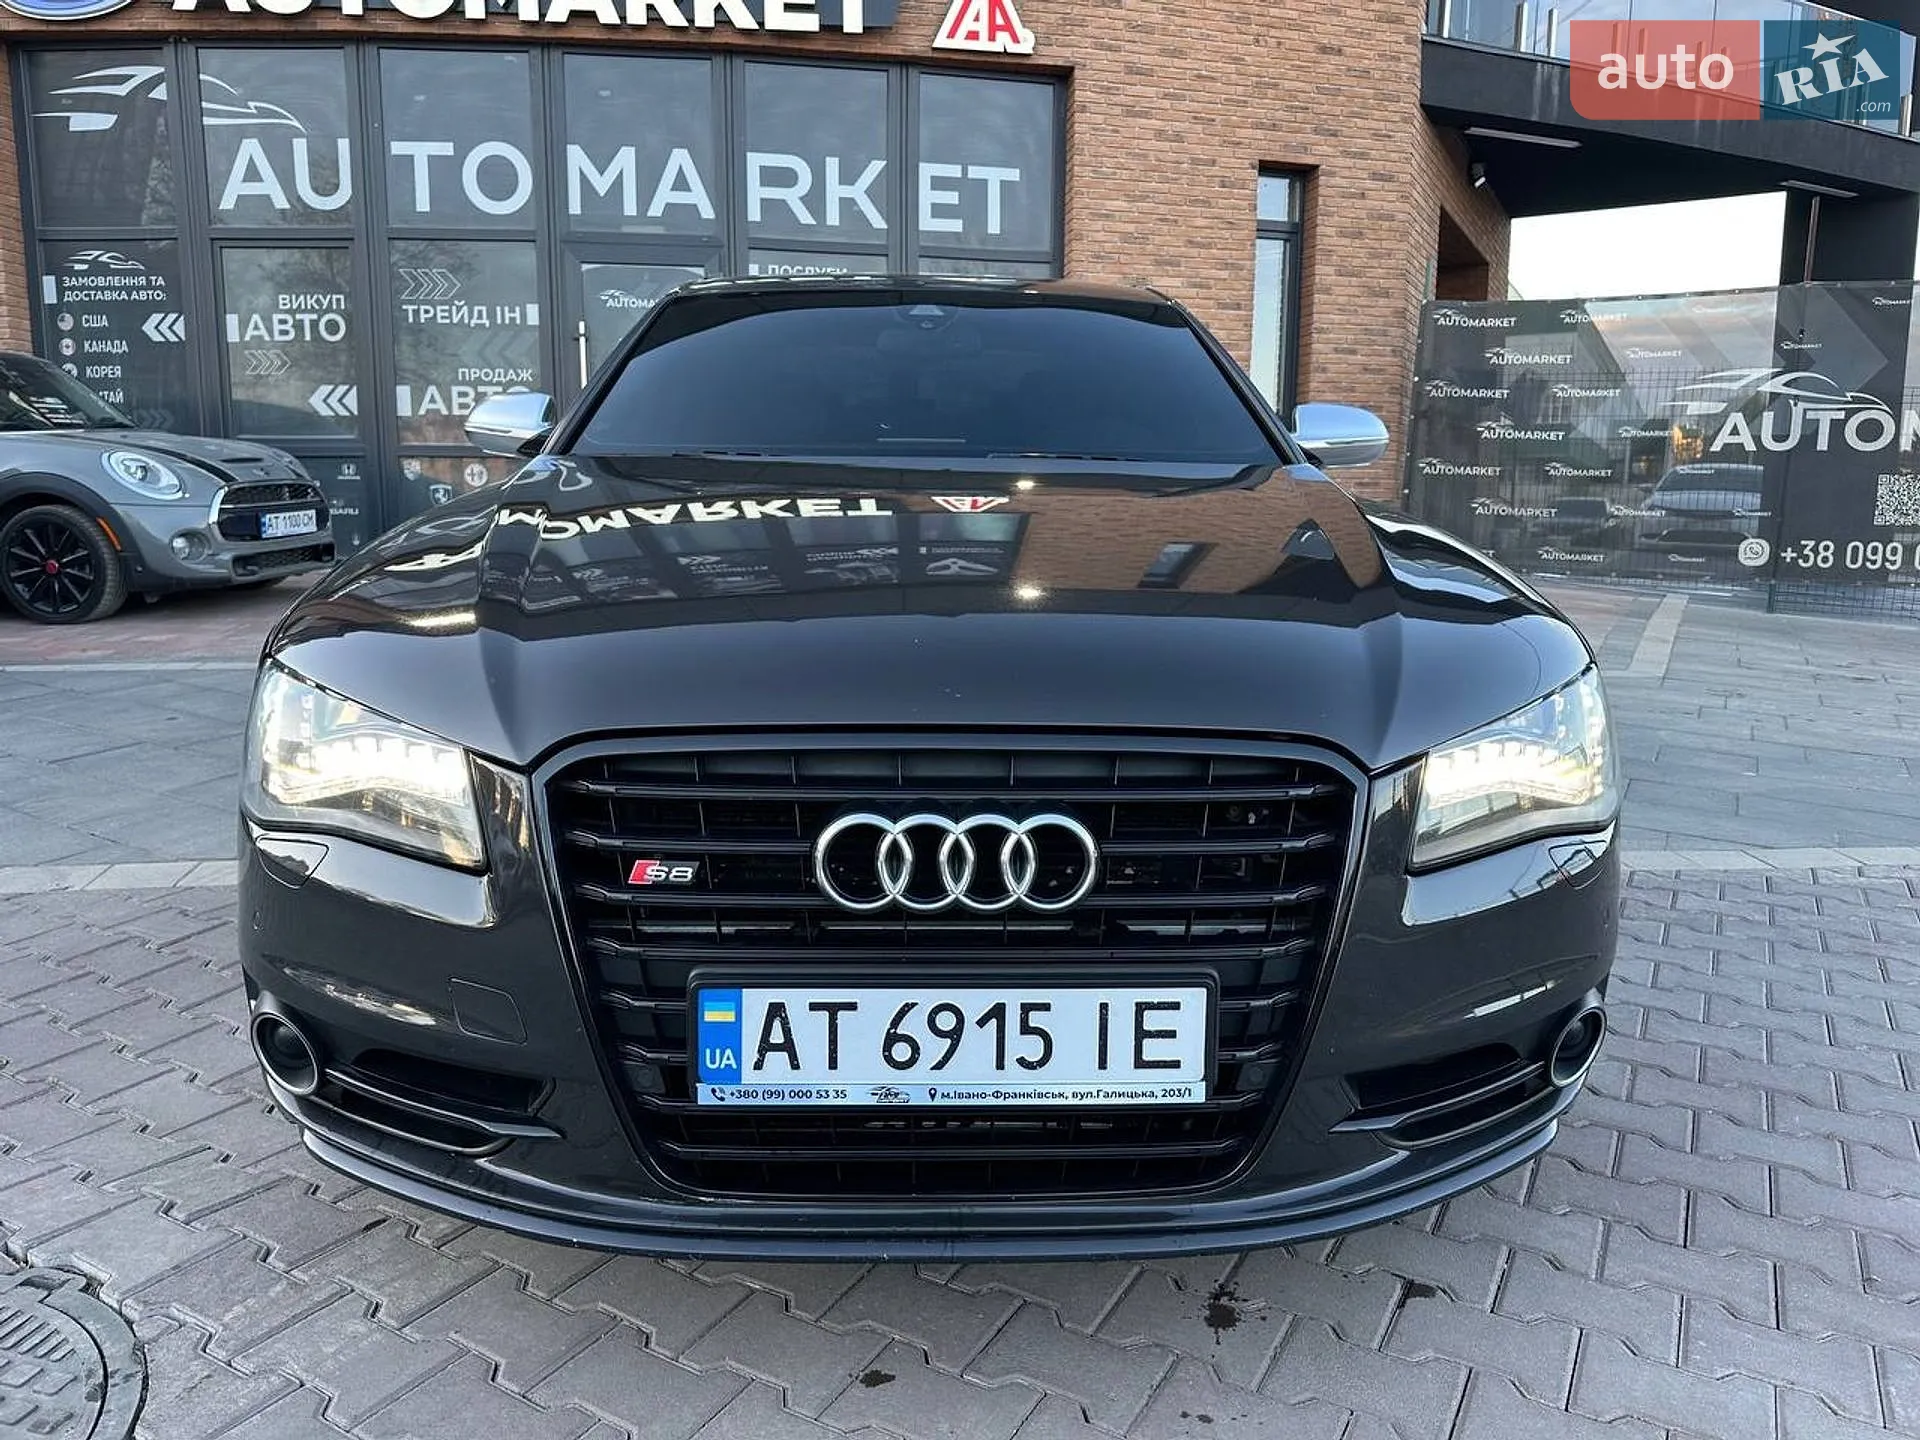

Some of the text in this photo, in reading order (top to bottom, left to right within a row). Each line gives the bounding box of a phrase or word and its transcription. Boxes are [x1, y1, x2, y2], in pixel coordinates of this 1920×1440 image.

[218, 137, 1020, 234] AUTOMARKET
[62, 275, 166, 287] ЗАМОВЛЕННЯ ТА
[63, 290, 167, 302] ДОСТАВКА АВТО:
[278, 293, 346, 311] ВИКУП
[81, 314, 109, 328] США
[401, 300, 521, 328] ТРЕЙД ІН
[243, 312, 347, 343] АВТО
[1437, 316, 1518, 328] AUTOMARKET
[83, 339, 129, 355] КАНАДА
[1489, 353, 1574, 366] AUTOMARKET
[85, 365, 122, 379] КОРЕЯ
[457, 367, 534, 384] ПРОДАЖ
[1429, 387, 1511, 400] AUTOMARKET
[1555, 387, 1622, 398] AUTOMARKET
[416, 384, 532, 416] АВ
[1481, 428, 1566, 442] AUTOMARKET
[1422, 464, 1502, 477] AUTOMARKET
[1547, 467, 1613, 478] AUTOMARKET
[1475, 505, 1559, 519] AUTOMARKET
[1541, 551, 1605, 562] AUTOMARKET
[1780, 540, 1835, 568] +38
[1844, 541, 1904, 570] 099
[646, 865, 693, 882] S8
[752, 1000, 1182, 1071] AT 6915 IE
[704, 1048, 738, 1069] UA
[729, 1087, 848, 1101] +380 (99) 000 53 35
[1160, 1087, 1192, 1099] 203/1
